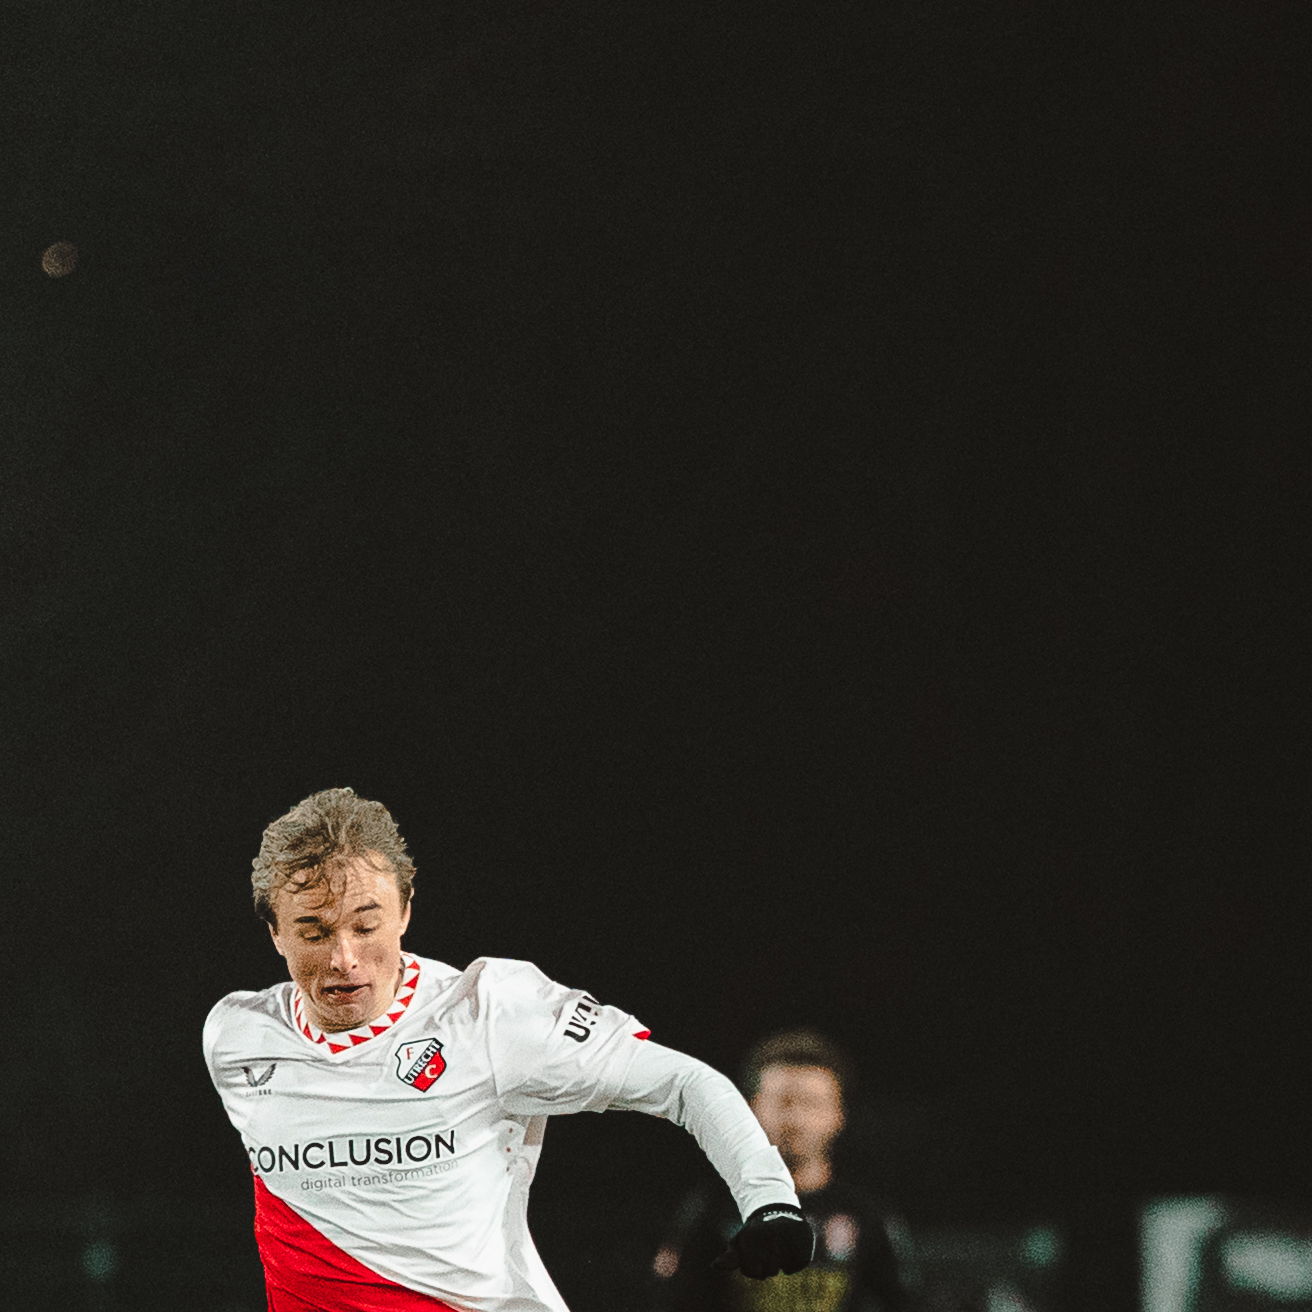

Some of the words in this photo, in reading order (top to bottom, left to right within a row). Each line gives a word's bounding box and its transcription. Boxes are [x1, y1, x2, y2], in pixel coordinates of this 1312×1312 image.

[403, 1040, 441, 1085] UTRECHT
[424, 1064, 439, 1079] C
[300, 1176, 347, 1192] digital
[351, 1158, 459, 1188] transformation
